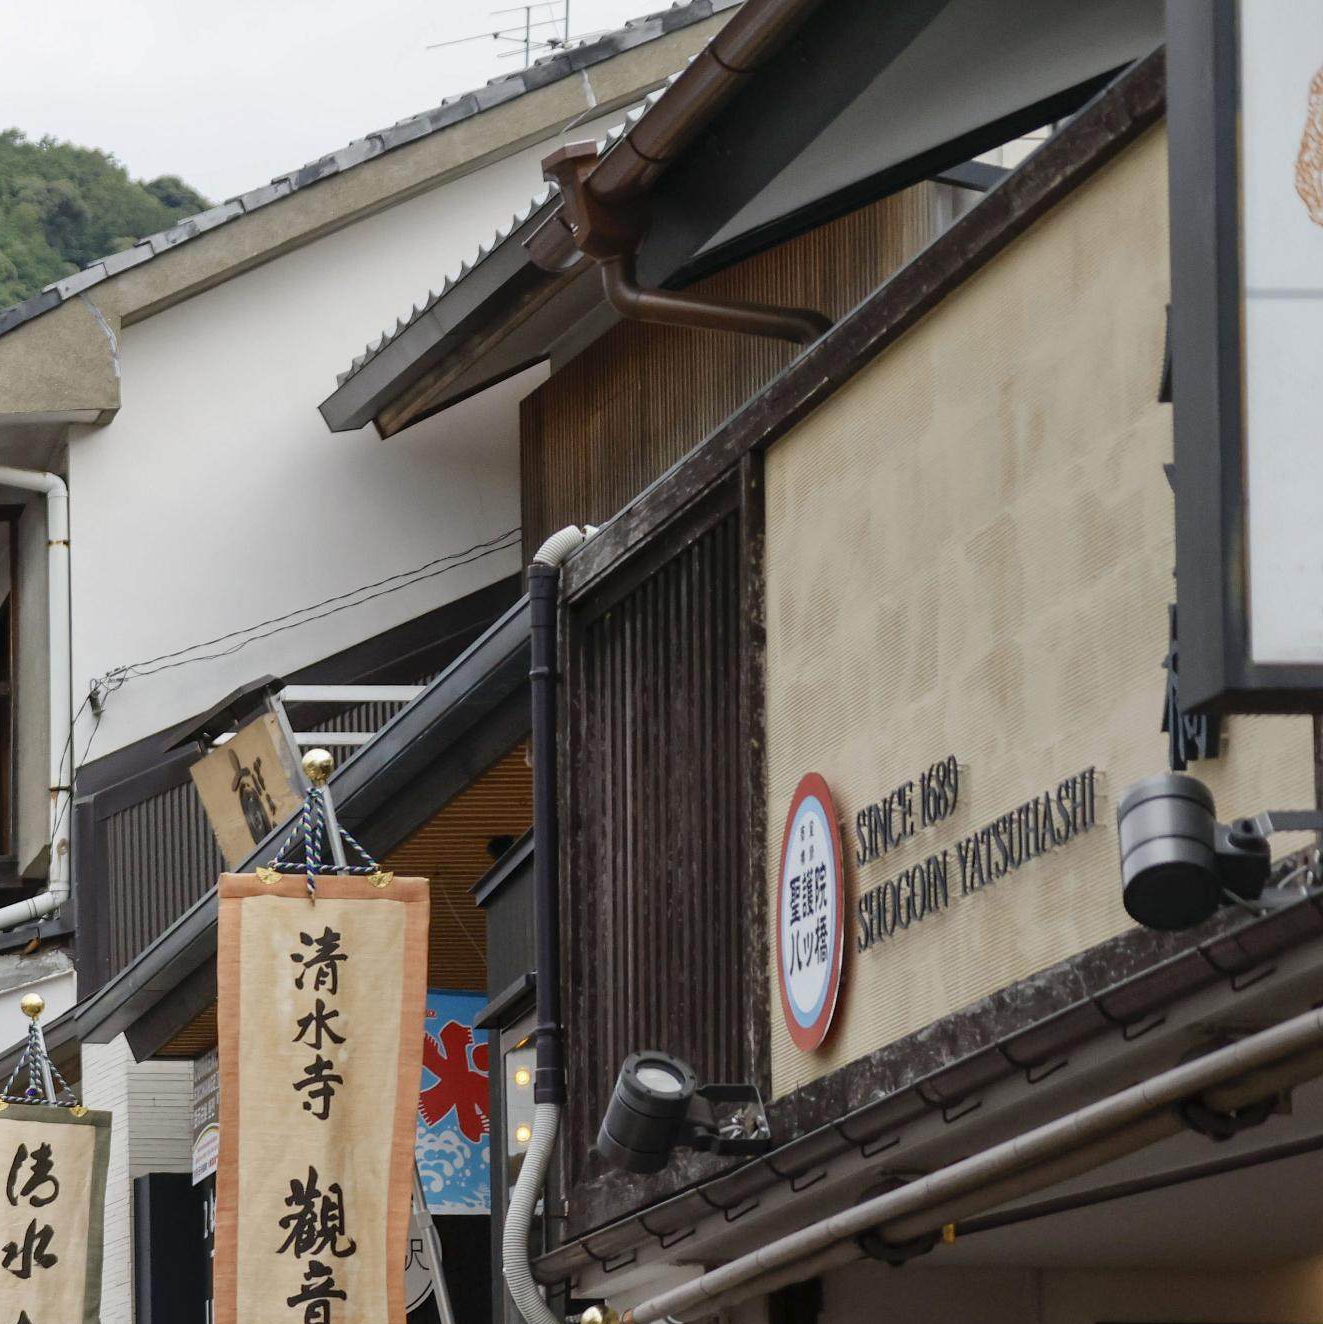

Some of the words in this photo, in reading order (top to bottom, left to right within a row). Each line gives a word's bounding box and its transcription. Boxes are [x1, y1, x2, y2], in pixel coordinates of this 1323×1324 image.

[856, 781, 914, 867] SINCE
[919, 755, 959, 829] 1689
[857, 850, 949, 953] SHOGOIN
[956, 765, 1096, 897] YATSUHASHI
